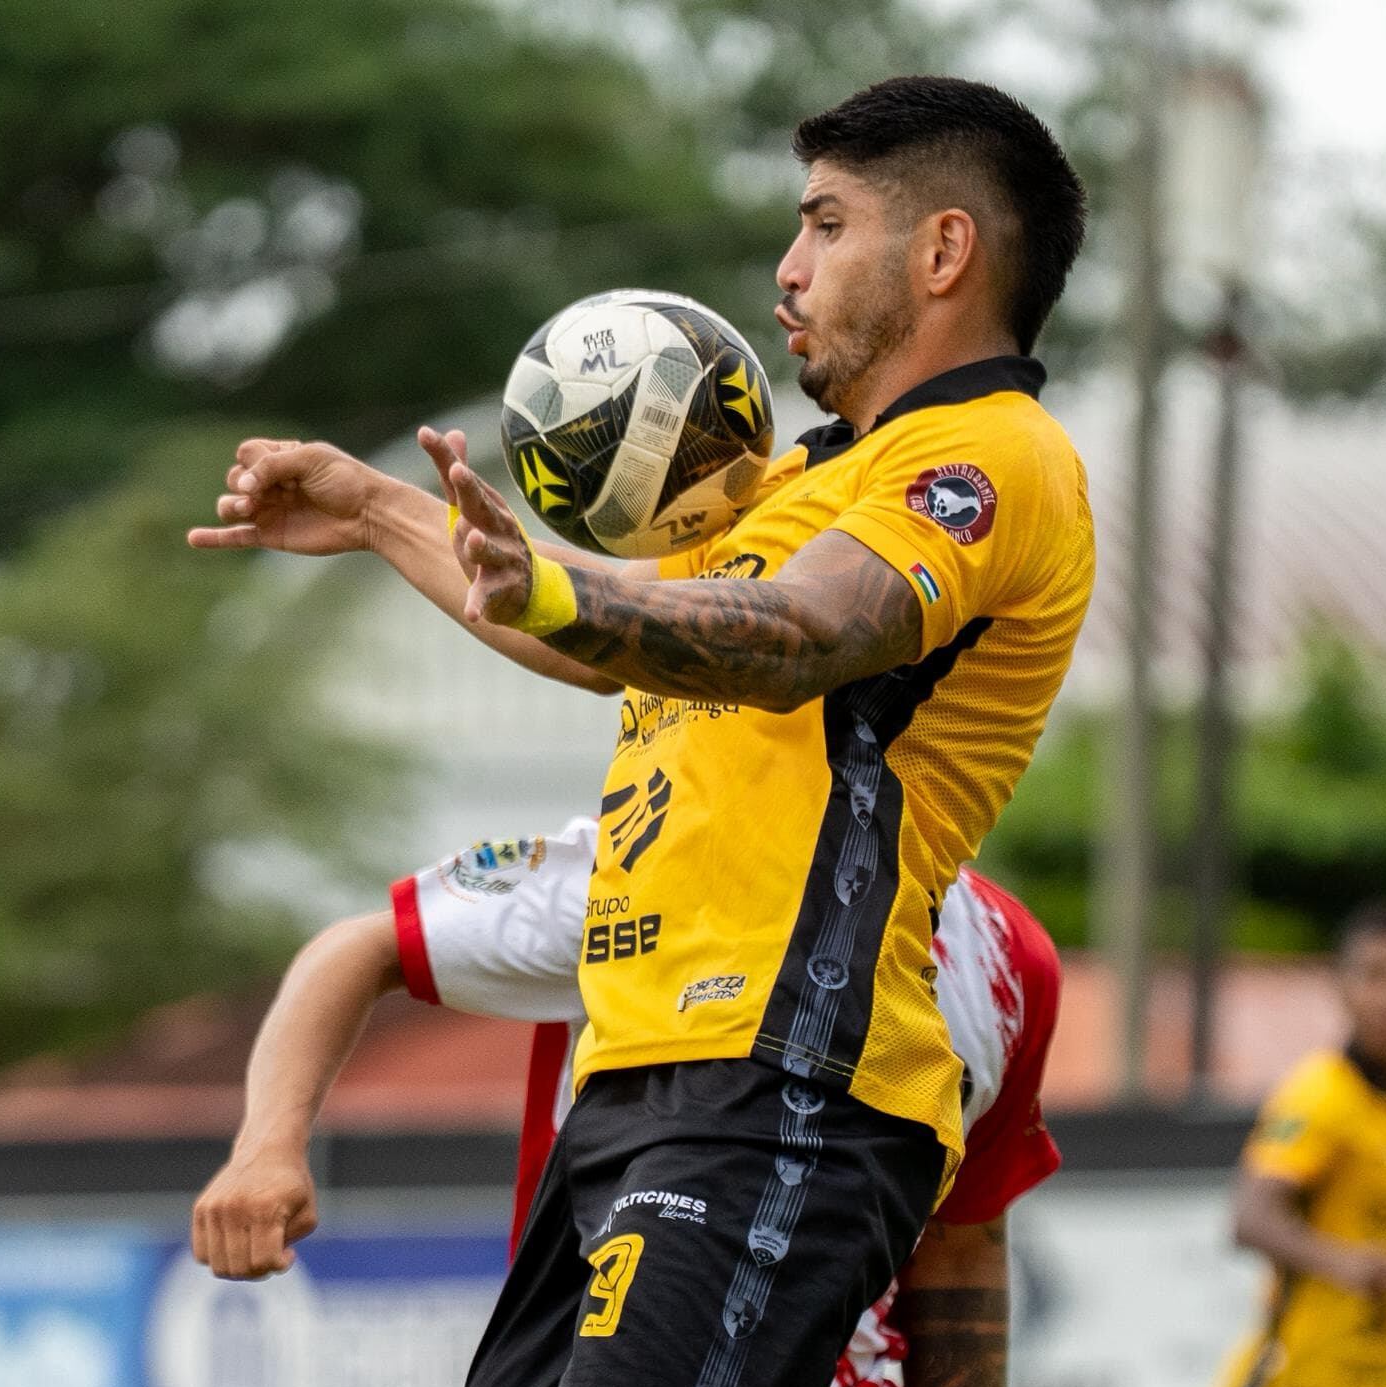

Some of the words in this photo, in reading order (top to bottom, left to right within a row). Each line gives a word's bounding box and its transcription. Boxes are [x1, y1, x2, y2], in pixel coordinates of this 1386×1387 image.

[580, 350, 632, 376] ML
[933, 465, 997, 506] RESTAURANTE
[658, 1203, 707, 1225] Liberia
[579, 1233, 645, 1337] 9
